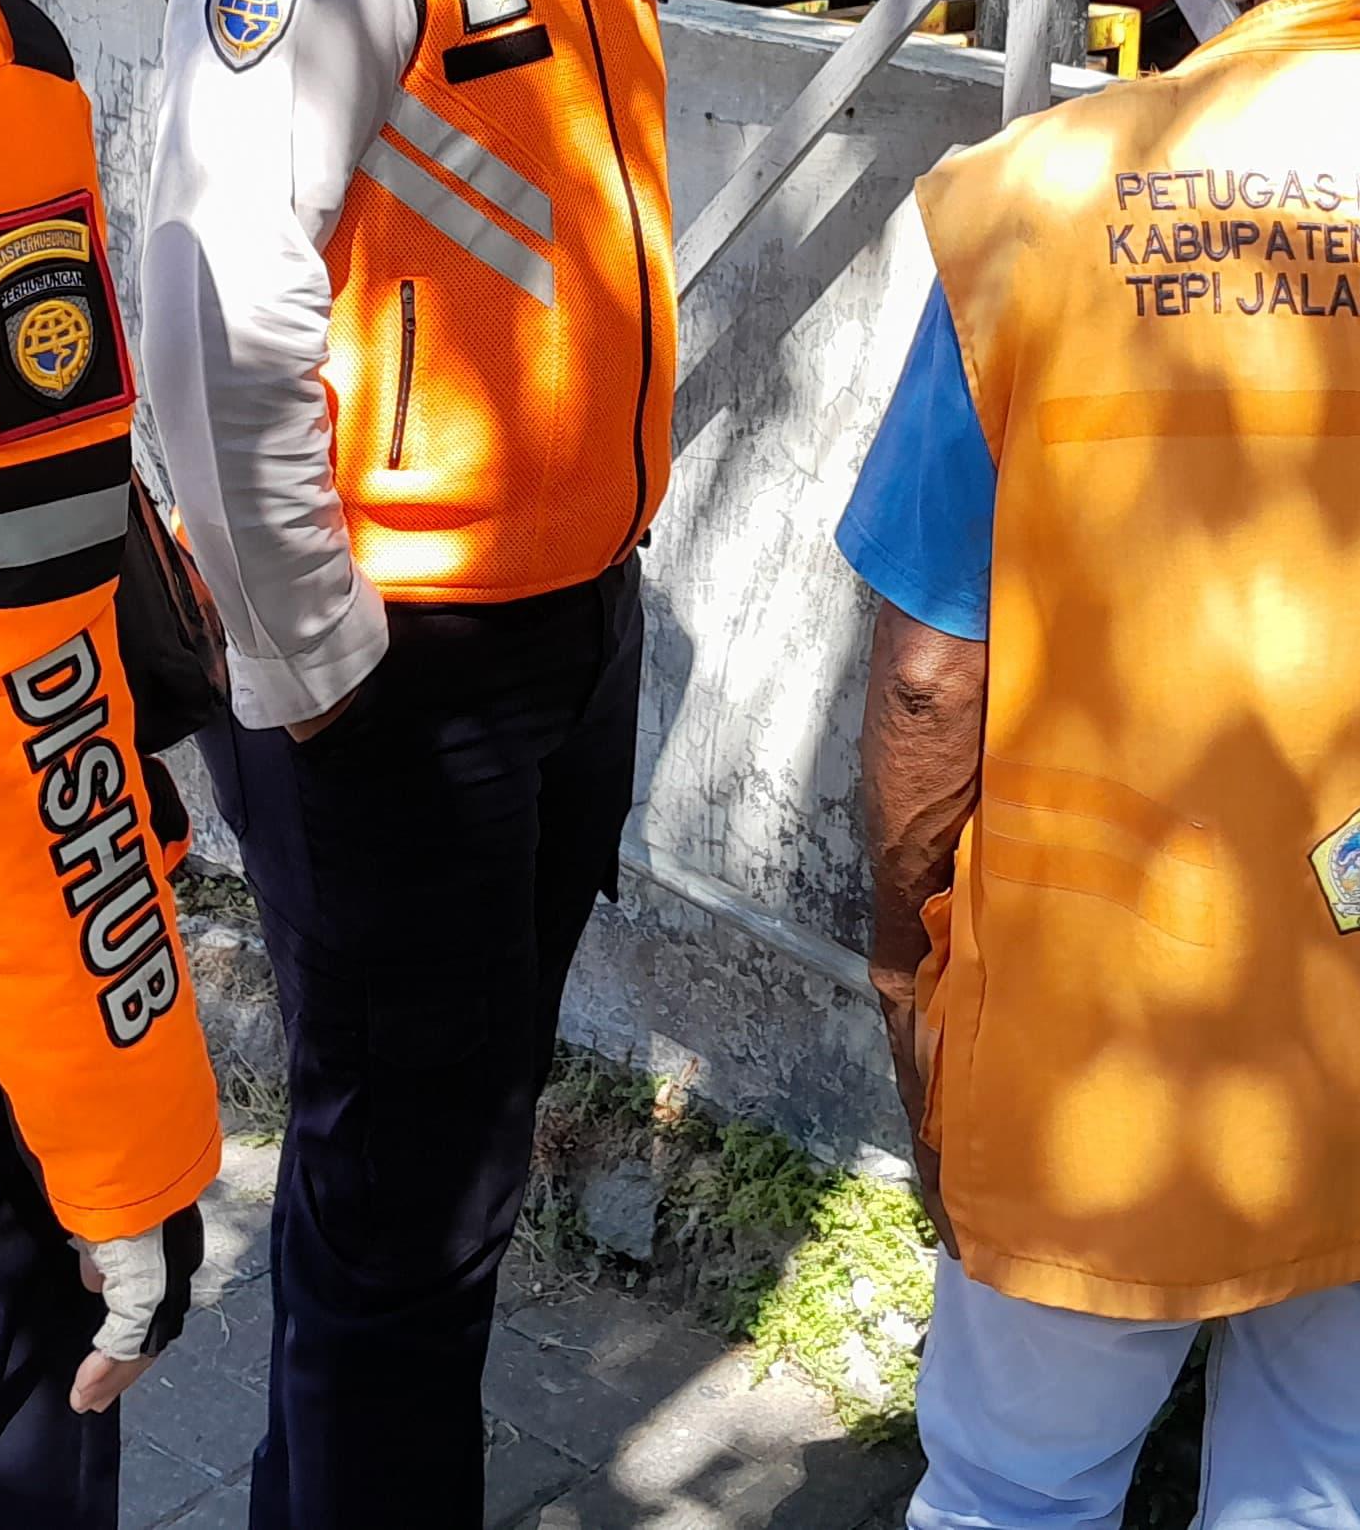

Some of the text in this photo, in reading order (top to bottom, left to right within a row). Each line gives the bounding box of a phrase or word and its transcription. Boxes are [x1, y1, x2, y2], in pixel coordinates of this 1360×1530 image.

[1115, 168, 1342, 213] PETUGAS
[1126, 273, 1223, 317] TEPI
[7, 631, 177, 1044] DISHUB
